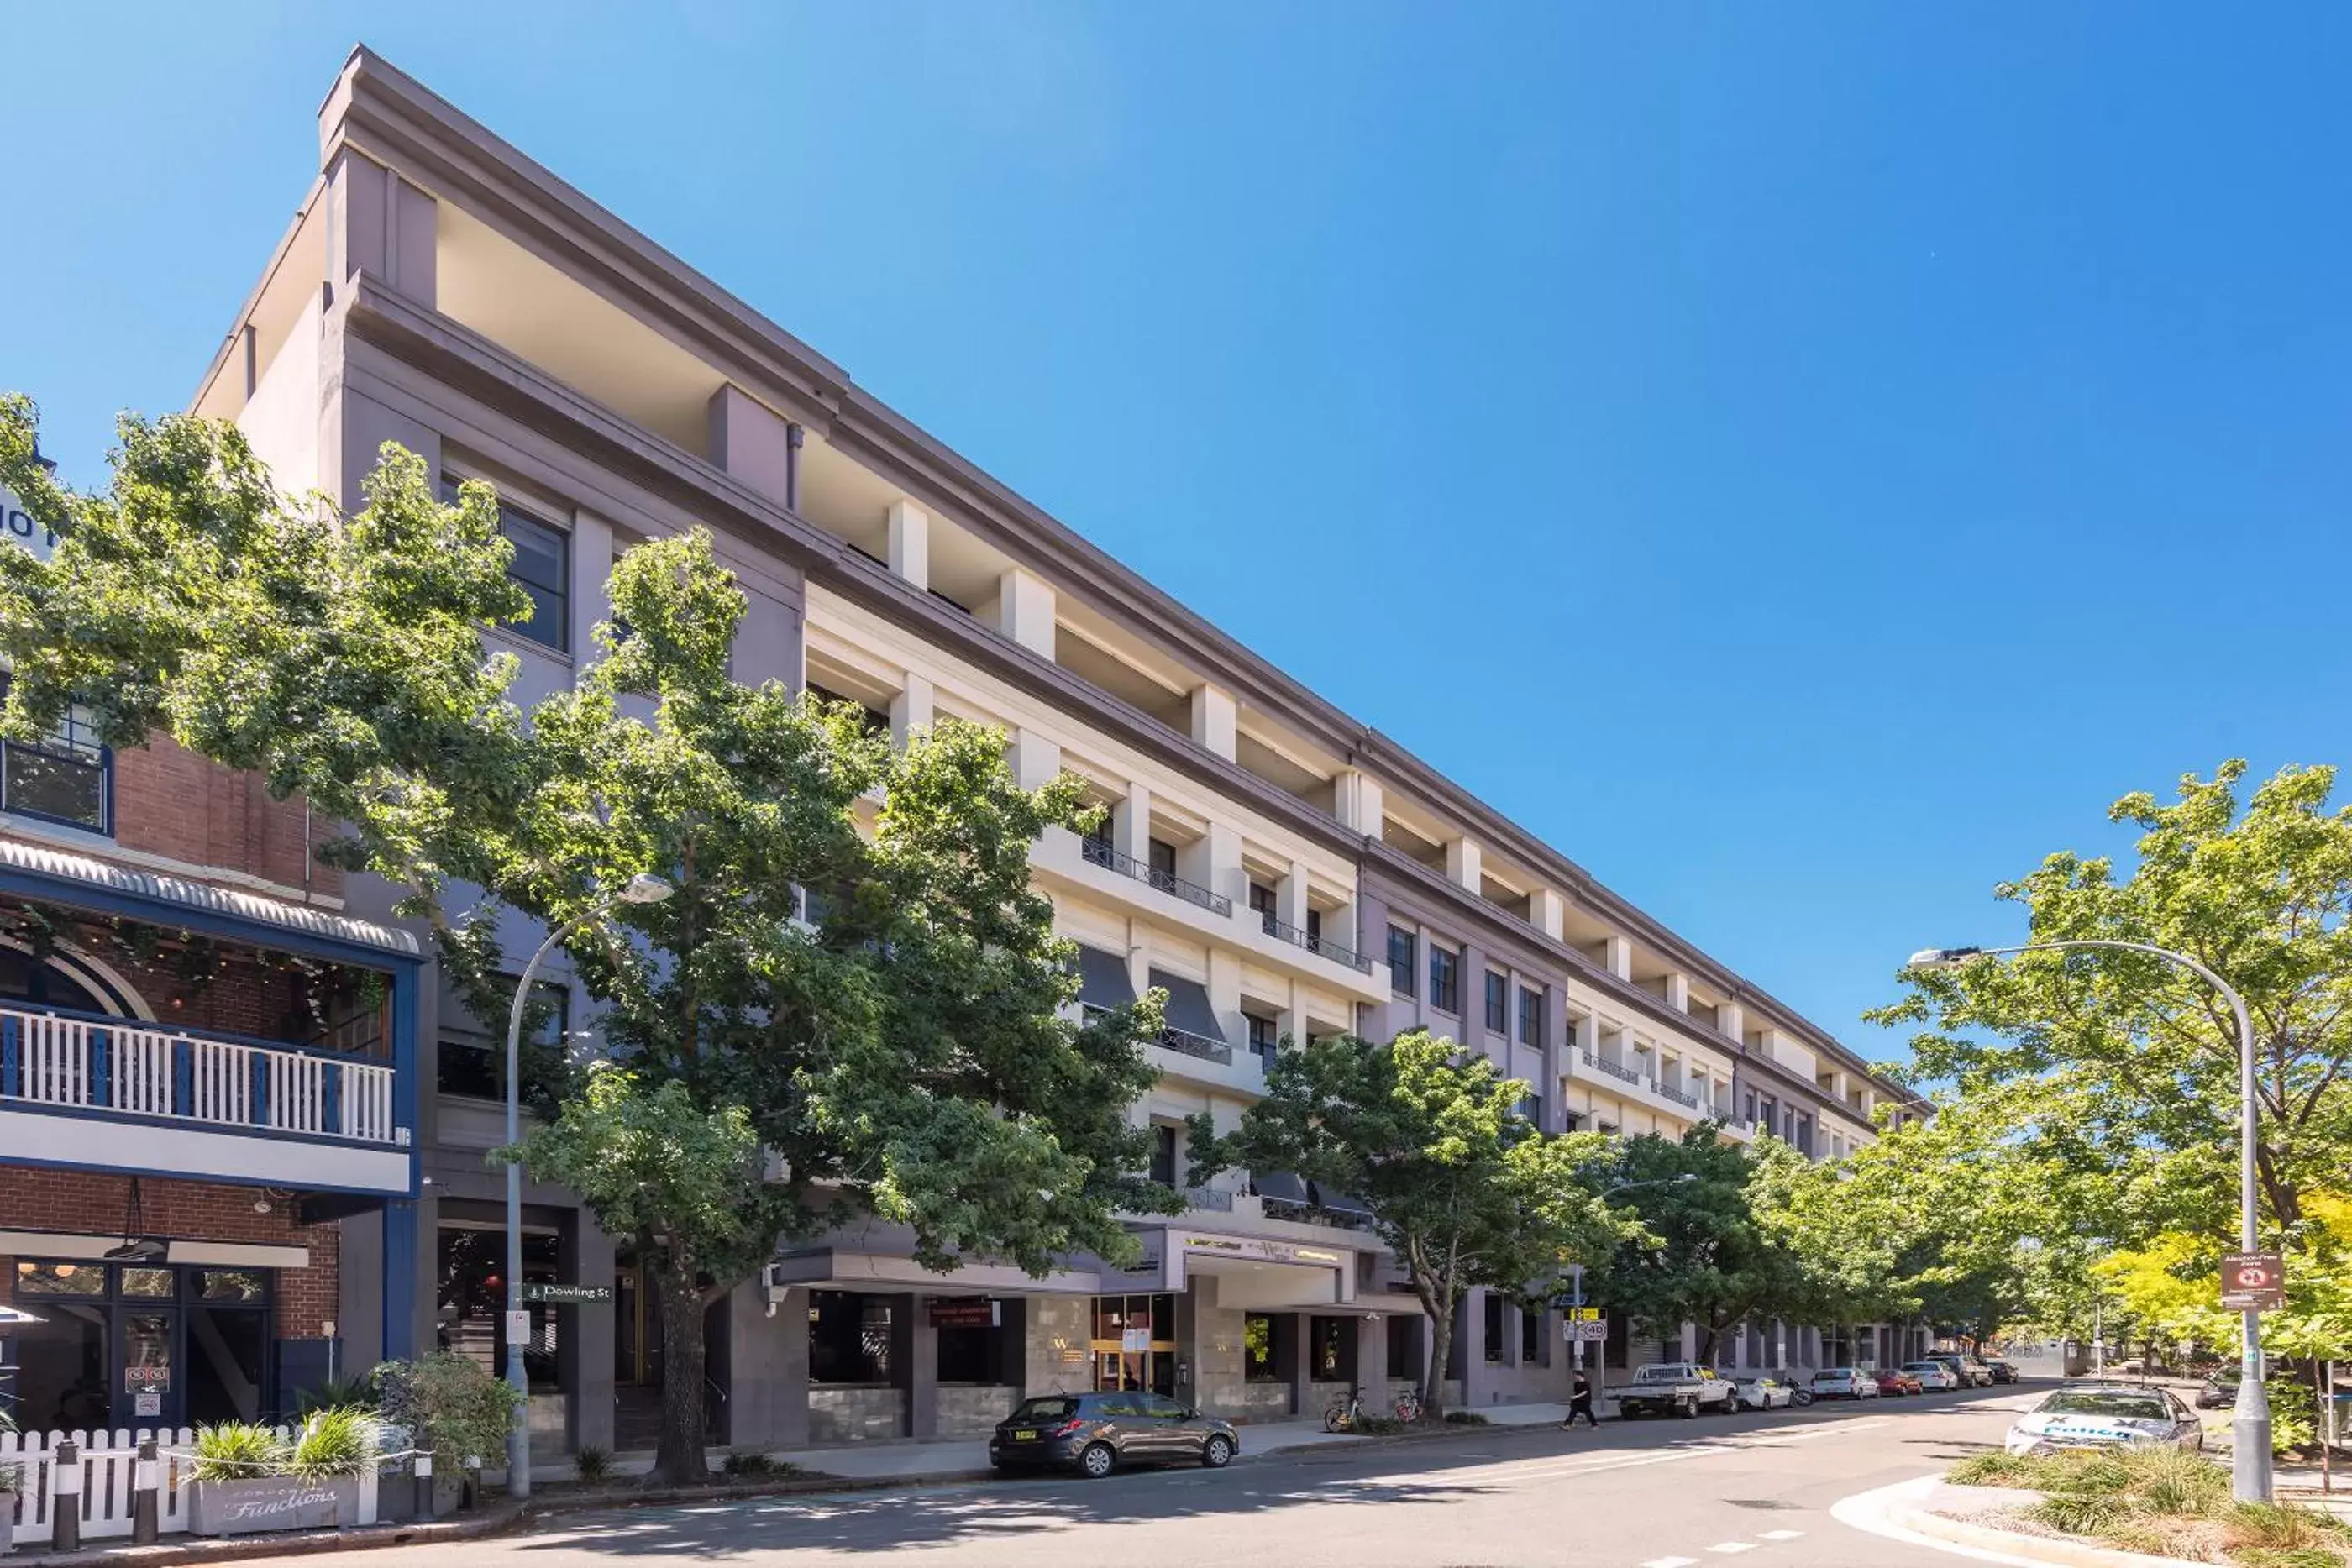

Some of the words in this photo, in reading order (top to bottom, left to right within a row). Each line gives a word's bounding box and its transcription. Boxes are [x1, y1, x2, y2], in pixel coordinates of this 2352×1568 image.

[544, 1285, 595, 1298] Dowling
[596, 1288, 609, 1298] St
[1588, 1325, 1604, 1334] 40
[224, 1490, 339, 1521] Functions
